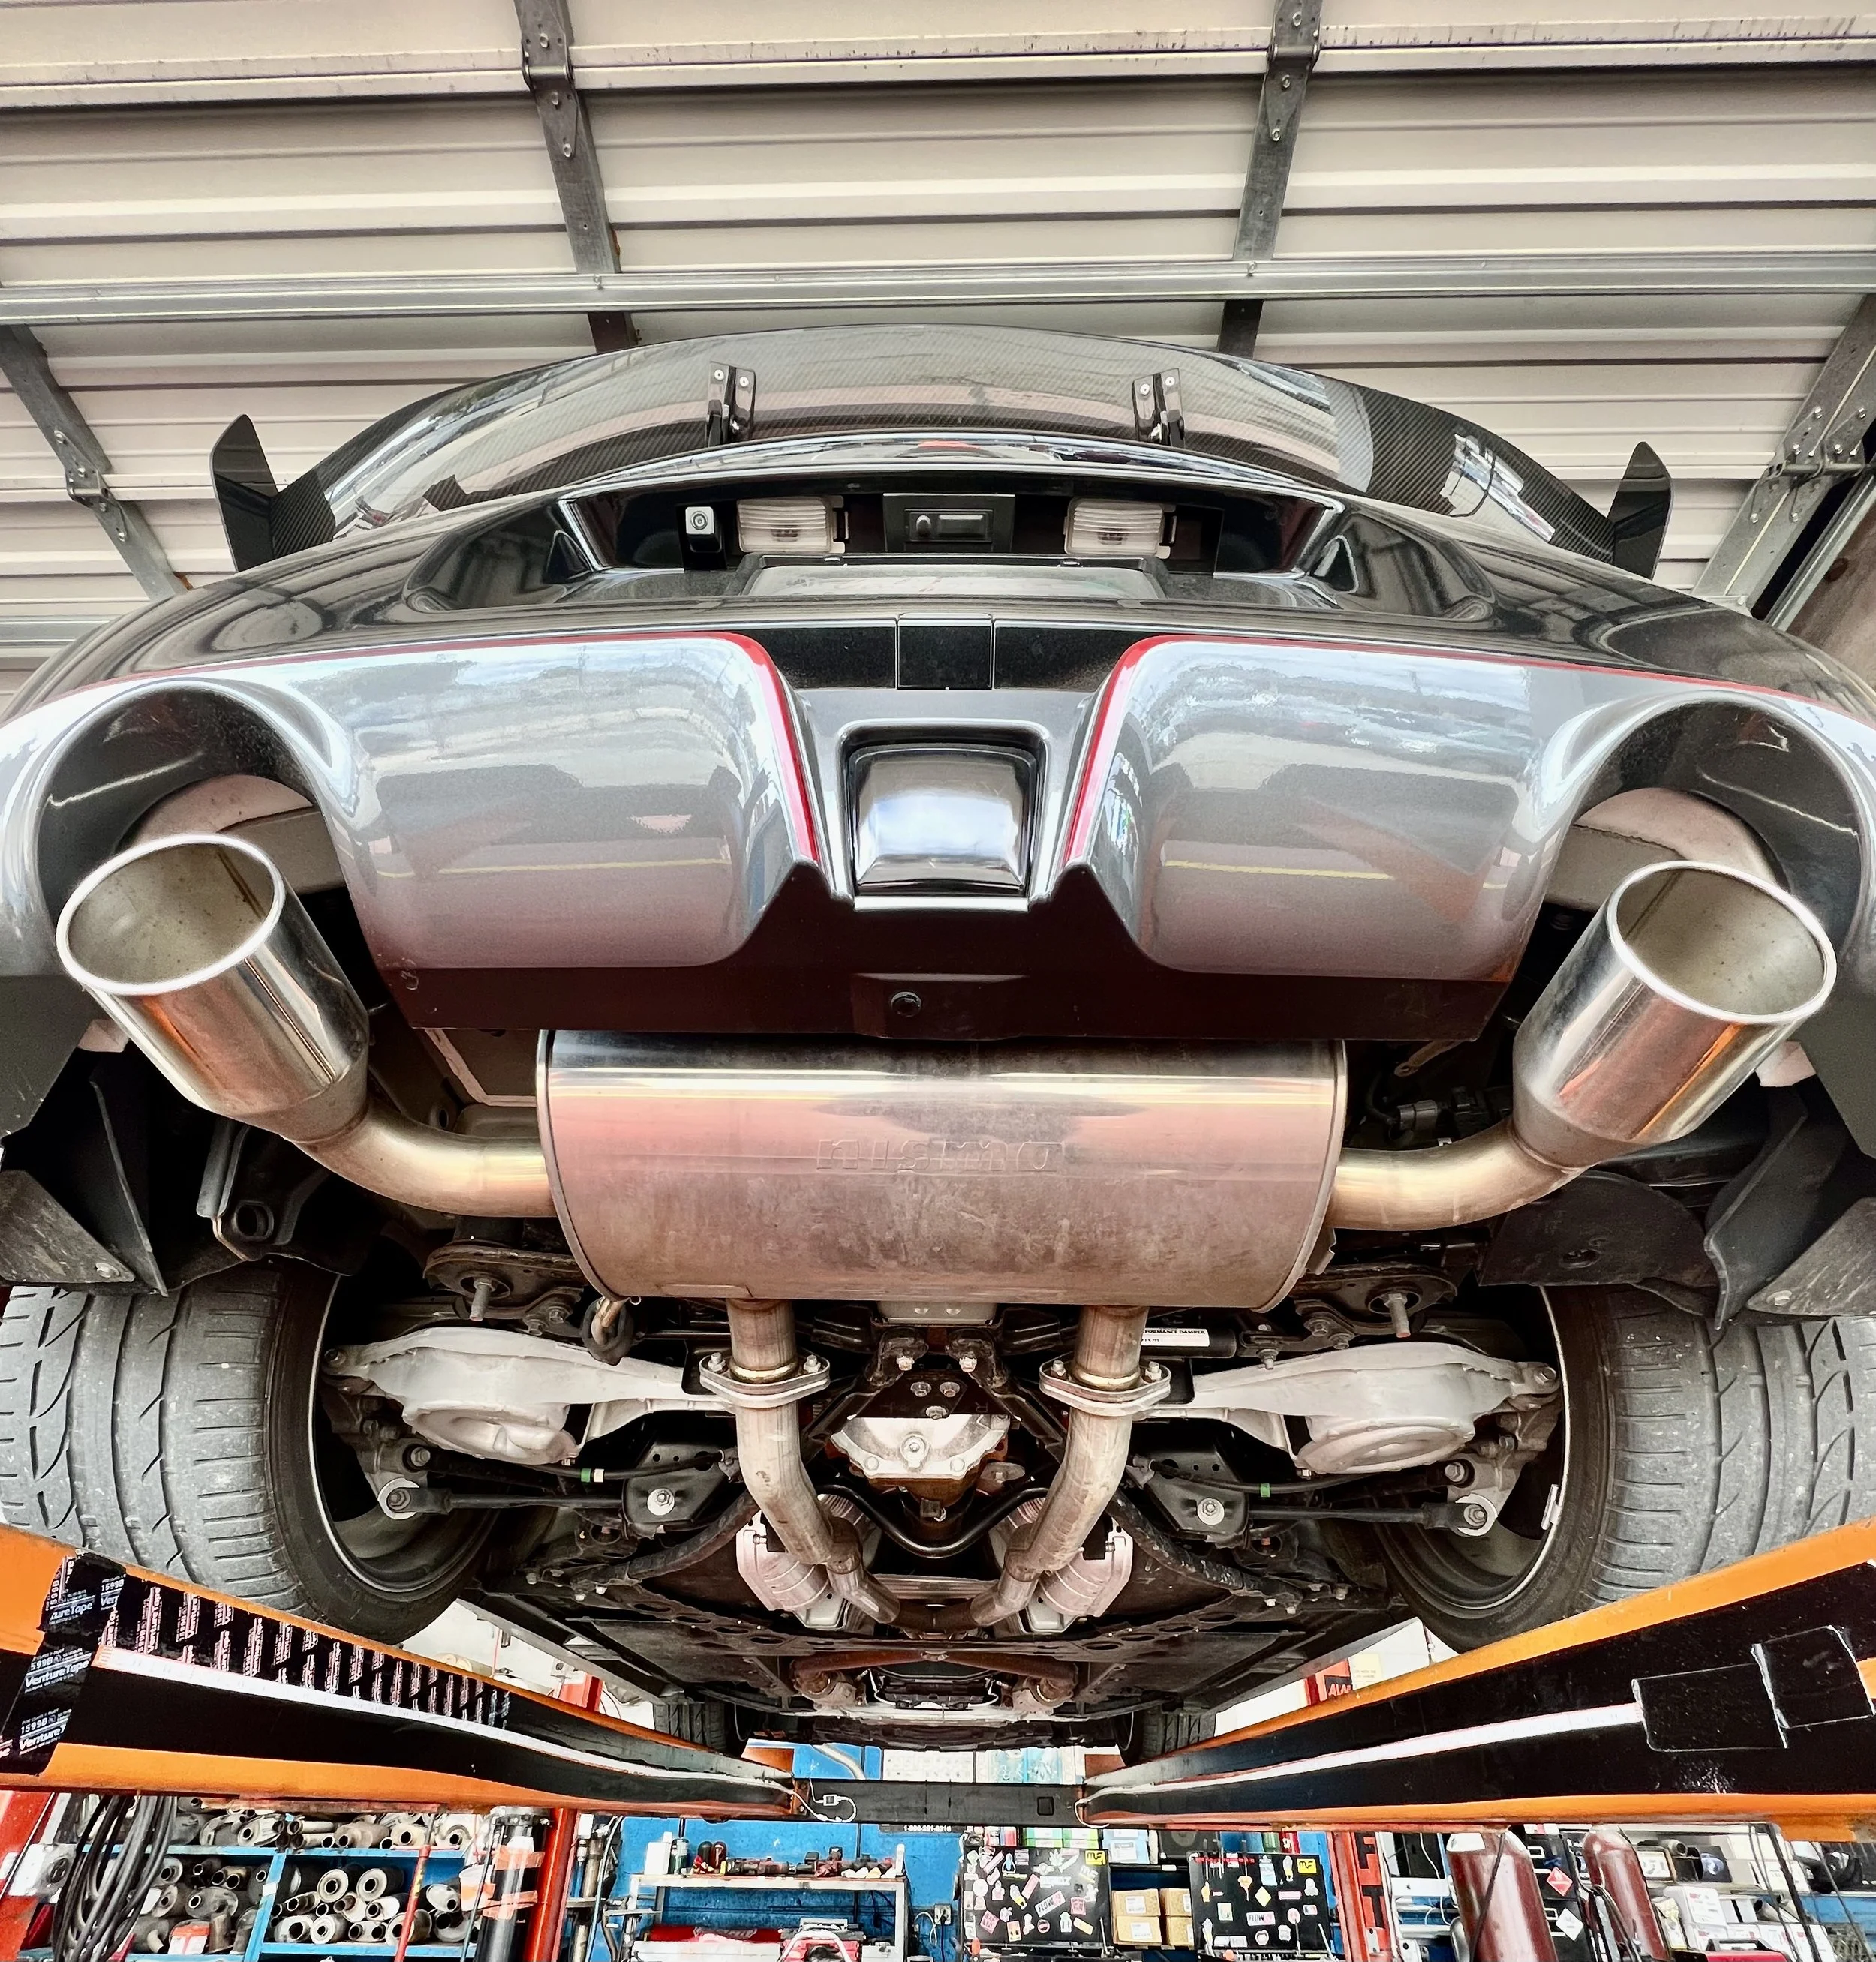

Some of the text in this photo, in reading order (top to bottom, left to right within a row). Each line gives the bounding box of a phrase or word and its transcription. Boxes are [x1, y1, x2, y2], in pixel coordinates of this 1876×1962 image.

[816, 1131, 1065, 1173] nismo
[25, 1660, 90, 1688] VentureTape
[21, 1717, 48, 1735] 1599B
